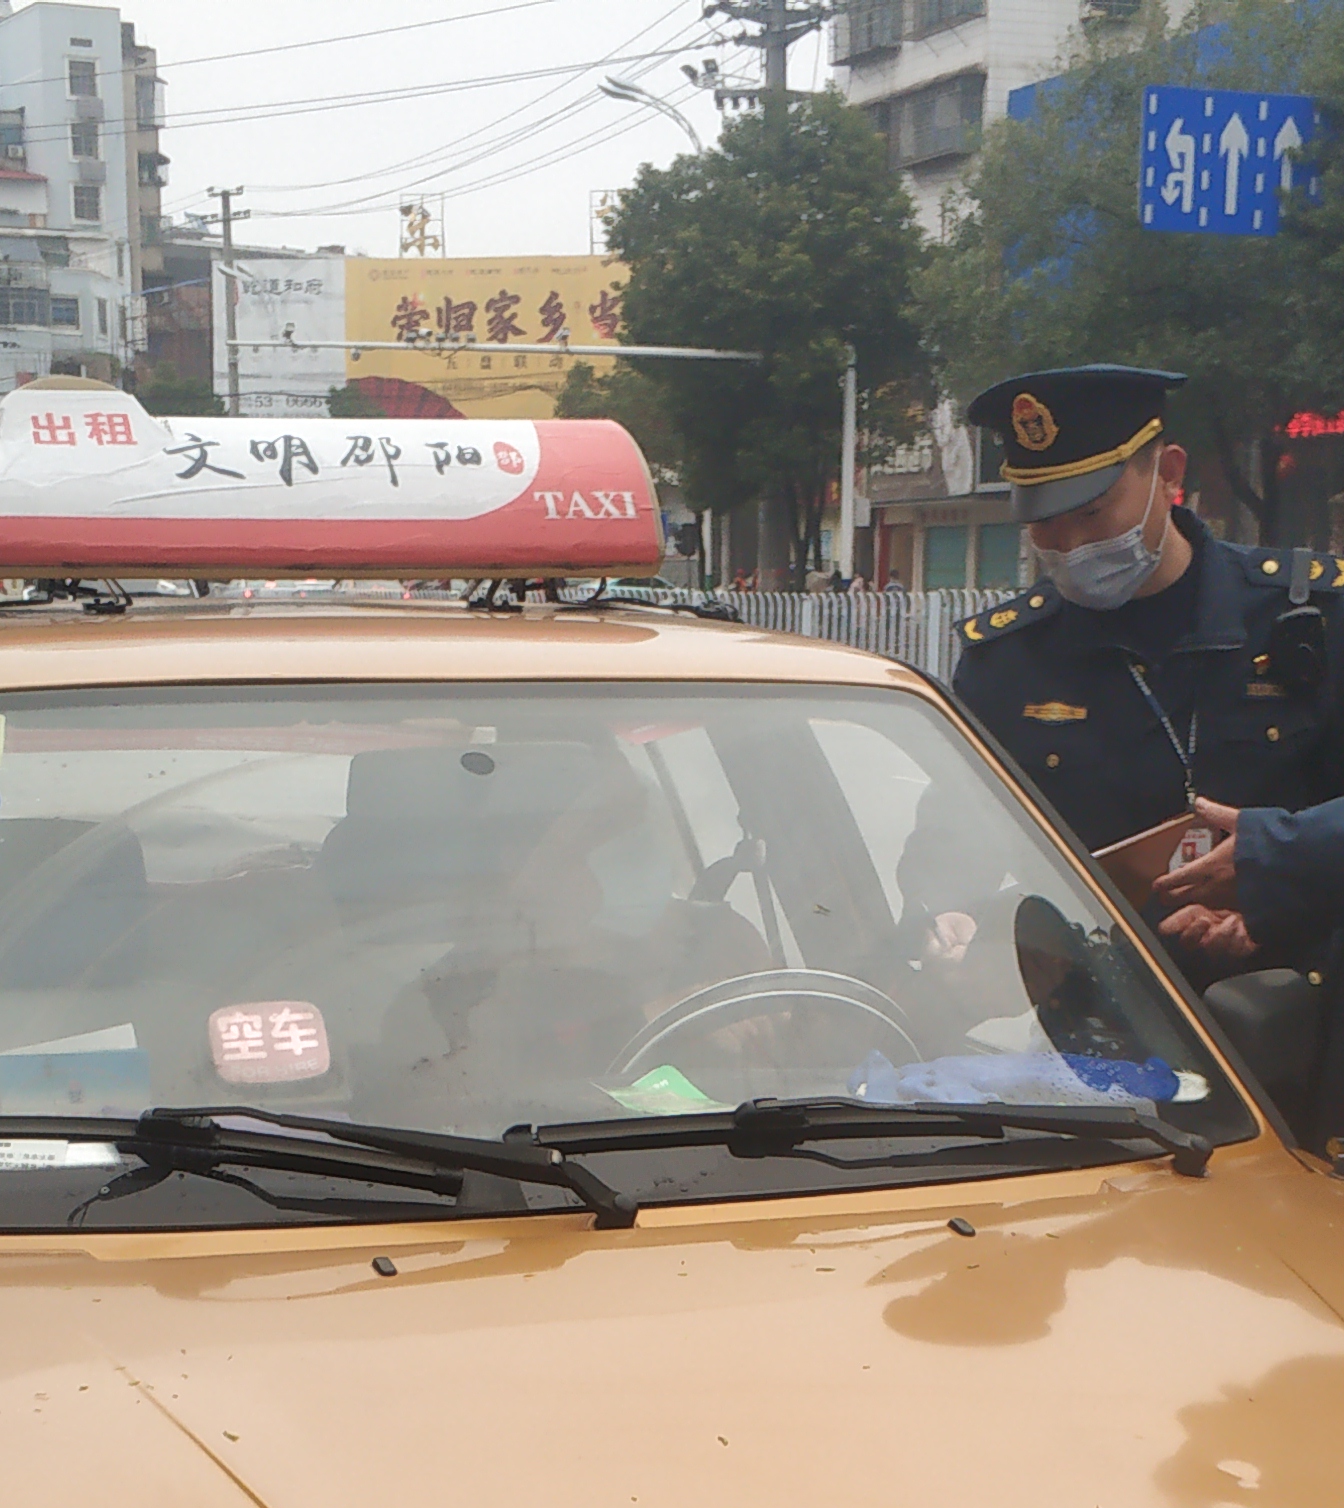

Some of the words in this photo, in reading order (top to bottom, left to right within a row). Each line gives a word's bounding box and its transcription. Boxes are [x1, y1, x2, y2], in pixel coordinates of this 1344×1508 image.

[30, 411, 138, 447] 出租
[163, 434, 483, 488] 文明邵阳
[533, 490, 639, 520] TAXI
[216, 1007, 319, 1061] 空车
